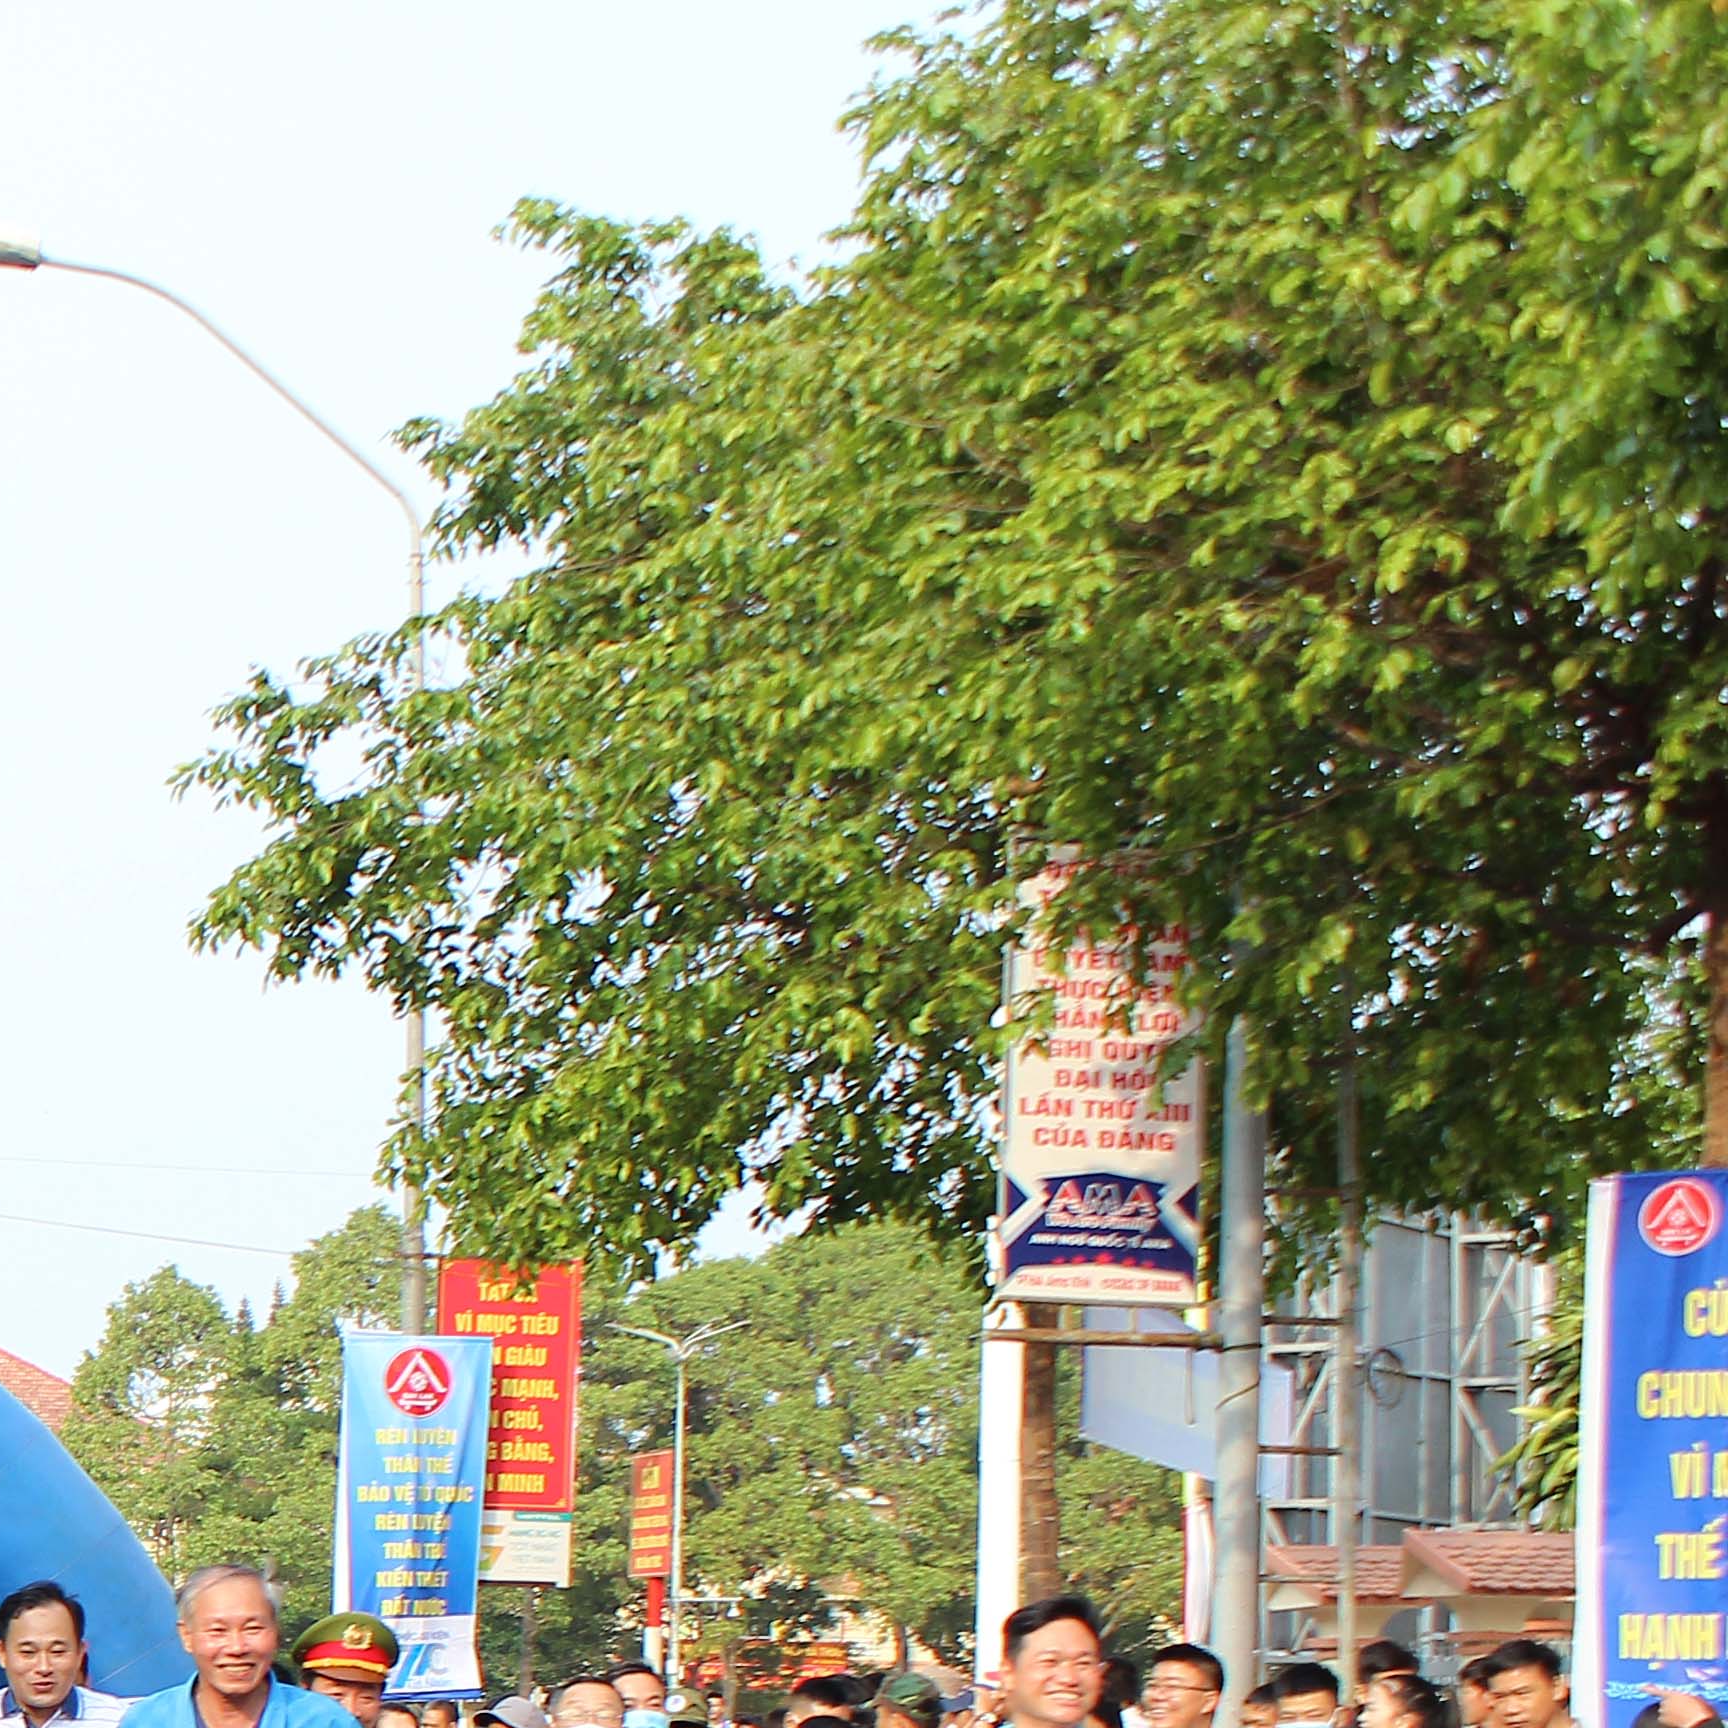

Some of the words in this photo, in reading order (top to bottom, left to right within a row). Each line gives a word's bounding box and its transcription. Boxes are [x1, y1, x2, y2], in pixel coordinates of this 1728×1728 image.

[1049, 1039, 1092, 1063] GHỊ
[1103, 1041, 1157, 1064] QUY
[1055, 1068, 1102, 1093] ĐẠI
[1082, 1098, 1137, 1120] THỨ
[1033, 1121, 1089, 1149] CỦA
[1098, 1125, 1176, 1152] ĐẢNG
[1046, 1180, 1159, 1217] AMA
[496, 1473, 546, 1493] MINH
[1618, 1612, 1723, 1671] HẠNH
